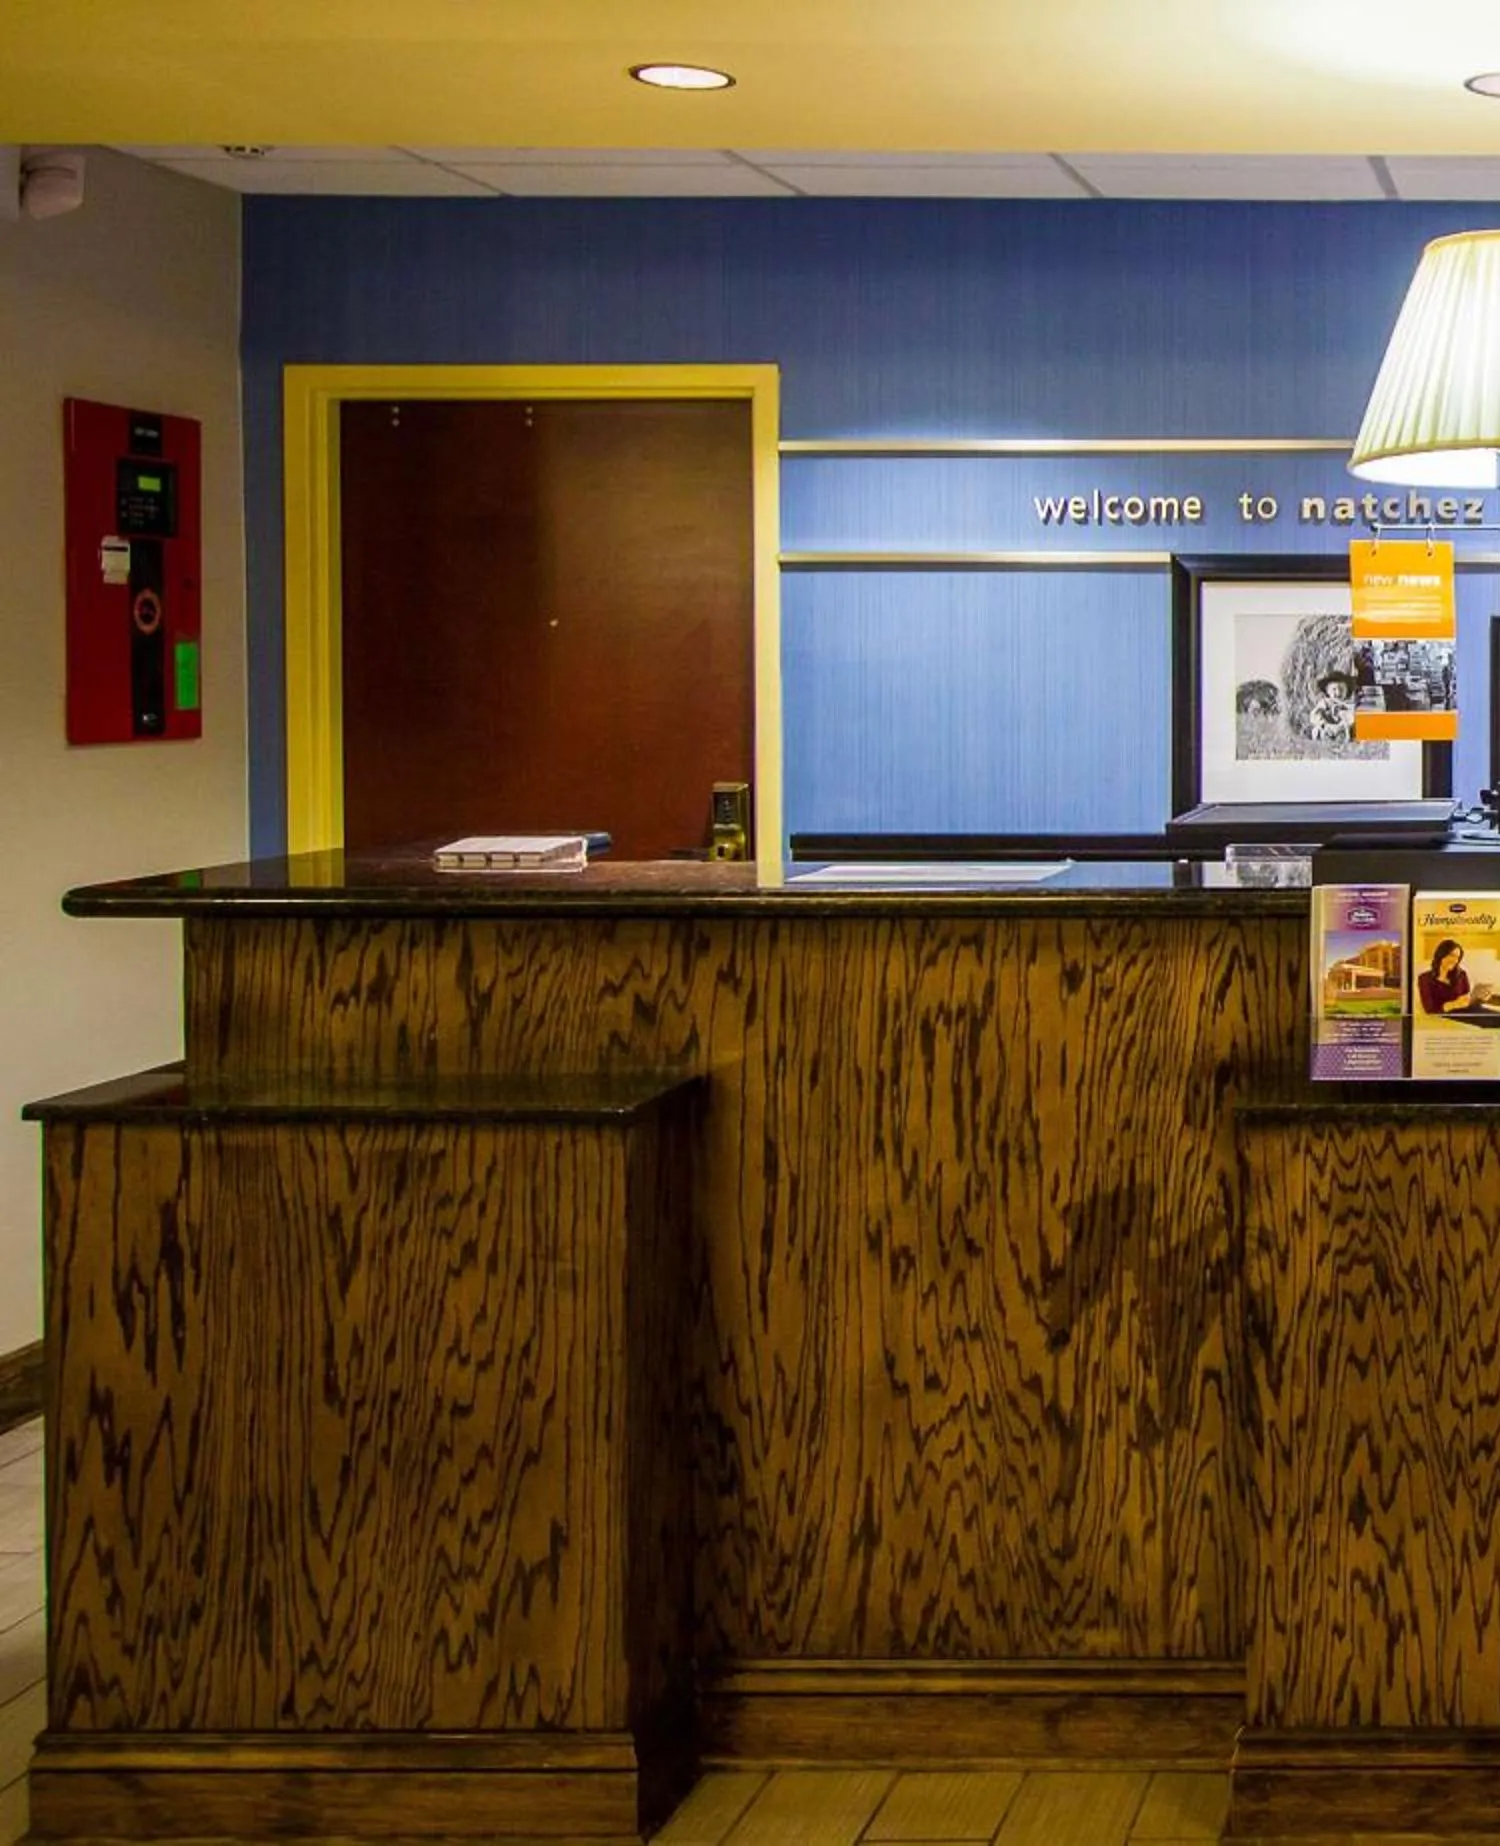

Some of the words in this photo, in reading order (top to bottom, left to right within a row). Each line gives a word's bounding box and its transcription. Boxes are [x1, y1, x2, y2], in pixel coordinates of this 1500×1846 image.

[1033, 488, 1203, 522] welcome
[1238, 491, 1279, 522] to
[1301, 488, 1486, 522] natchez
